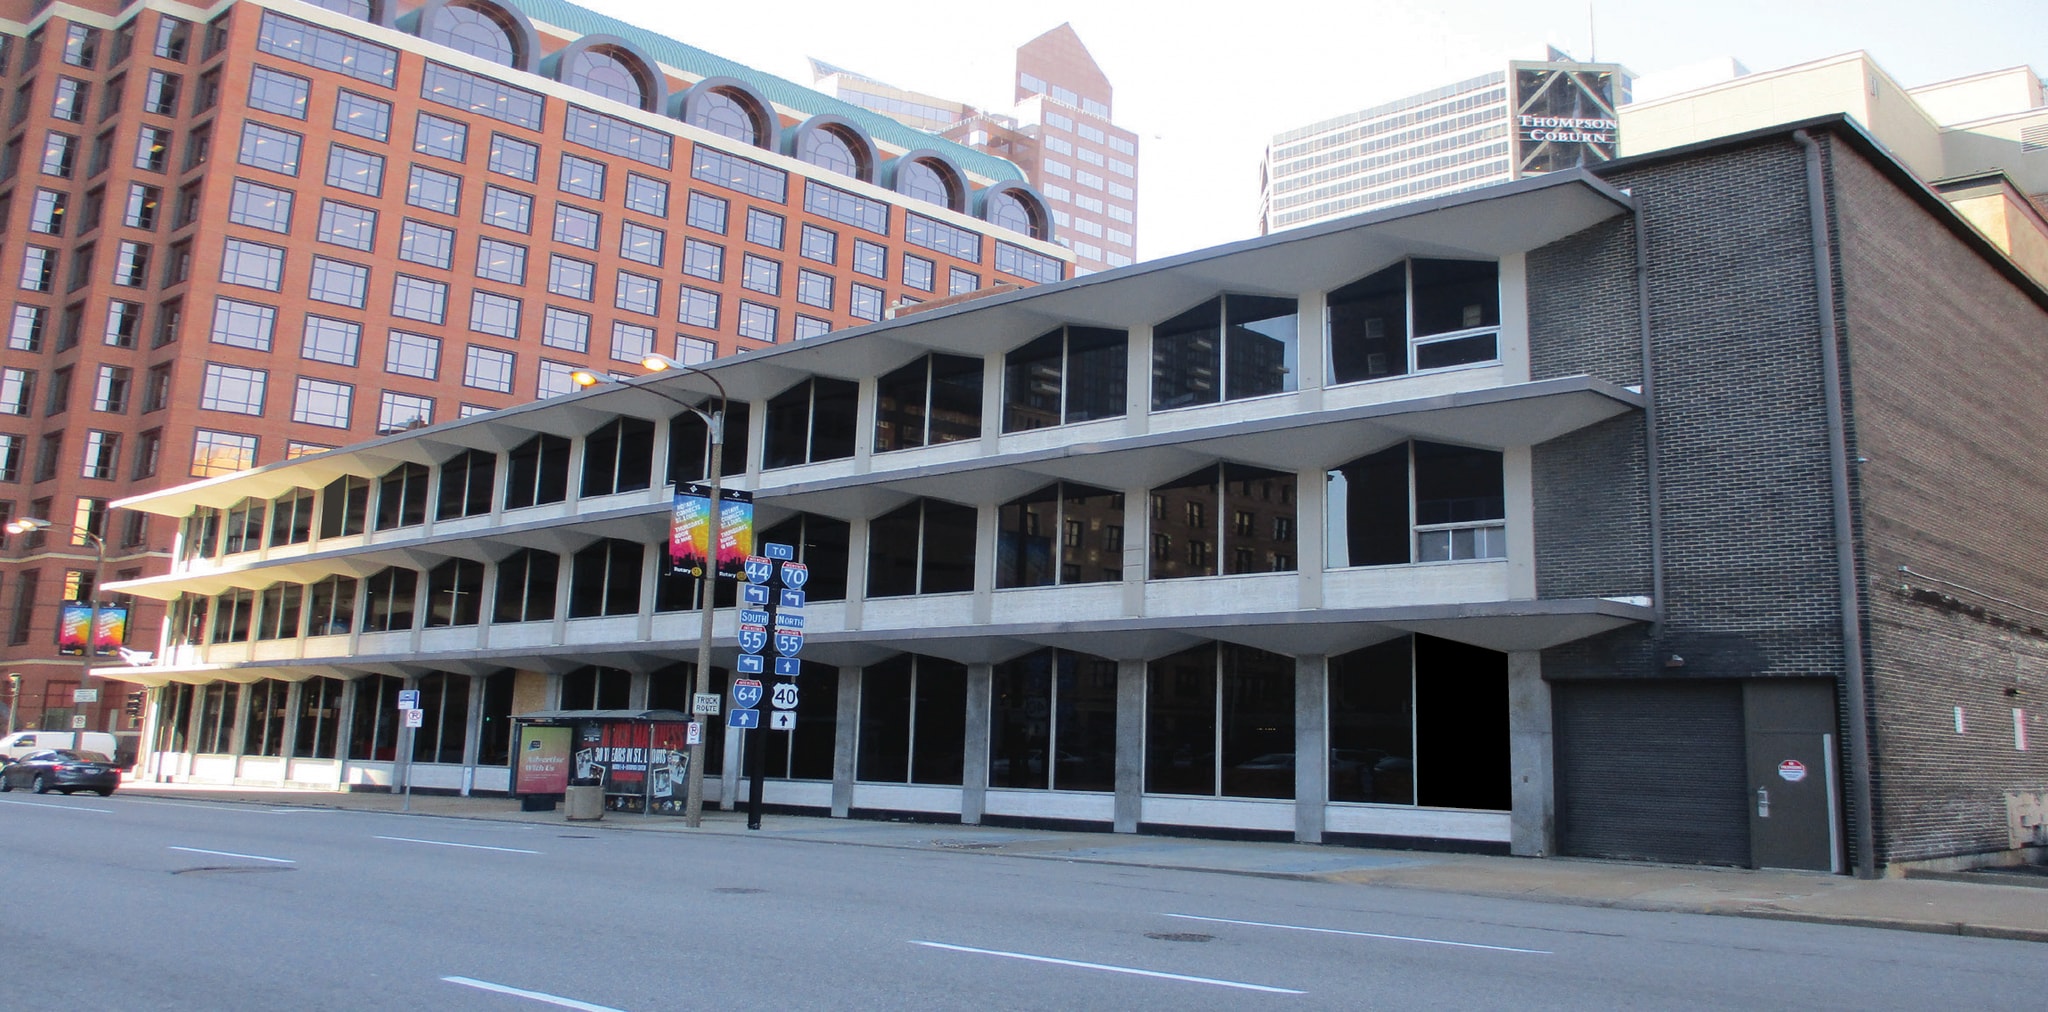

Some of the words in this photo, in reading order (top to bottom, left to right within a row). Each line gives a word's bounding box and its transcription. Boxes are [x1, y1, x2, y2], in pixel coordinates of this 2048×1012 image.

[1517, 114, 1617, 129] THOMPSON
[1530, 129, 1606, 143] COBURN
[772, 546, 786, 556] TO
[673, 566, 691, 574] Rotary
[719, 571, 736, 579] Rotary
[747, 563, 769, 580] 44
[784, 568, 804, 585] 70
[741, 611, 767, 623] SOUTH
[778, 615, 804, 626] NORTH
[743, 631, 762, 649] 55
[780, 635, 799, 652] 55
[697, 696, 718, 704] TRUCK
[738, 687, 757, 701] 64
[775, 688, 796, 705] 40
[594, 747, 604, 762] 30
